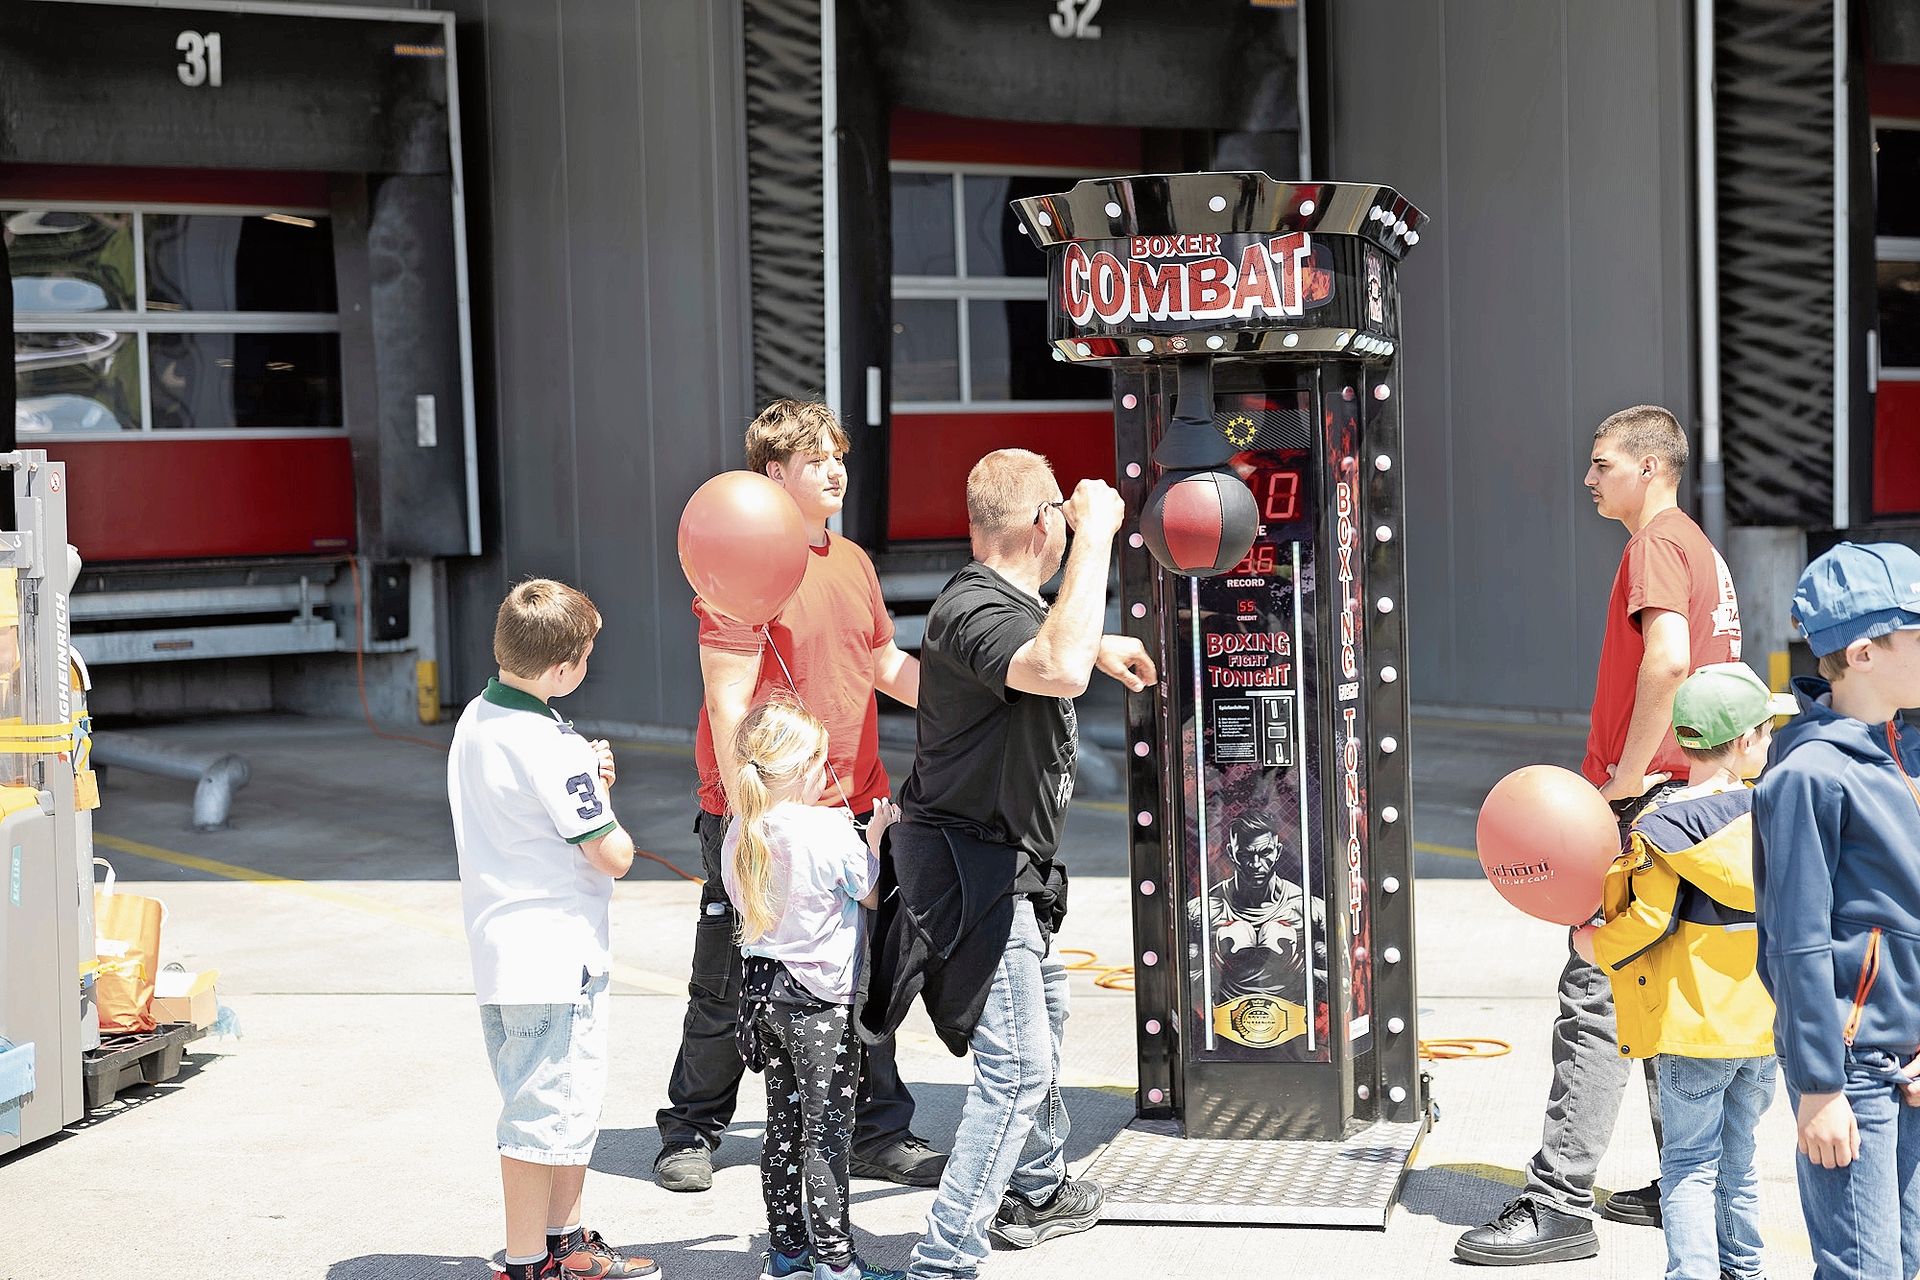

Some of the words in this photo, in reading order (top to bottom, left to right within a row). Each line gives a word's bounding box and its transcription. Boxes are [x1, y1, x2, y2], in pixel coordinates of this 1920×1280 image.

[1049, 0, 1102, 39] 32
[176, 29, 222, 87] 31
[1131, 233, 1221, 259] BOXER
[1063, 231, 1311, 326] COMBAT
[1226, 579, 1265, 588] RECORD
[1336, 482, 1356, 678] BOXING
[1236, 614, 1257, 622] CREDIT
[1206, 631, 1291, 658] BOXING
[1228, 654, 1269, 667] FIGHT
[1208, 663, 1291, 688] TONIGHT
[565, 772, 603, 820] 3
[1343, 707, 1362, 936] TONIGHT
